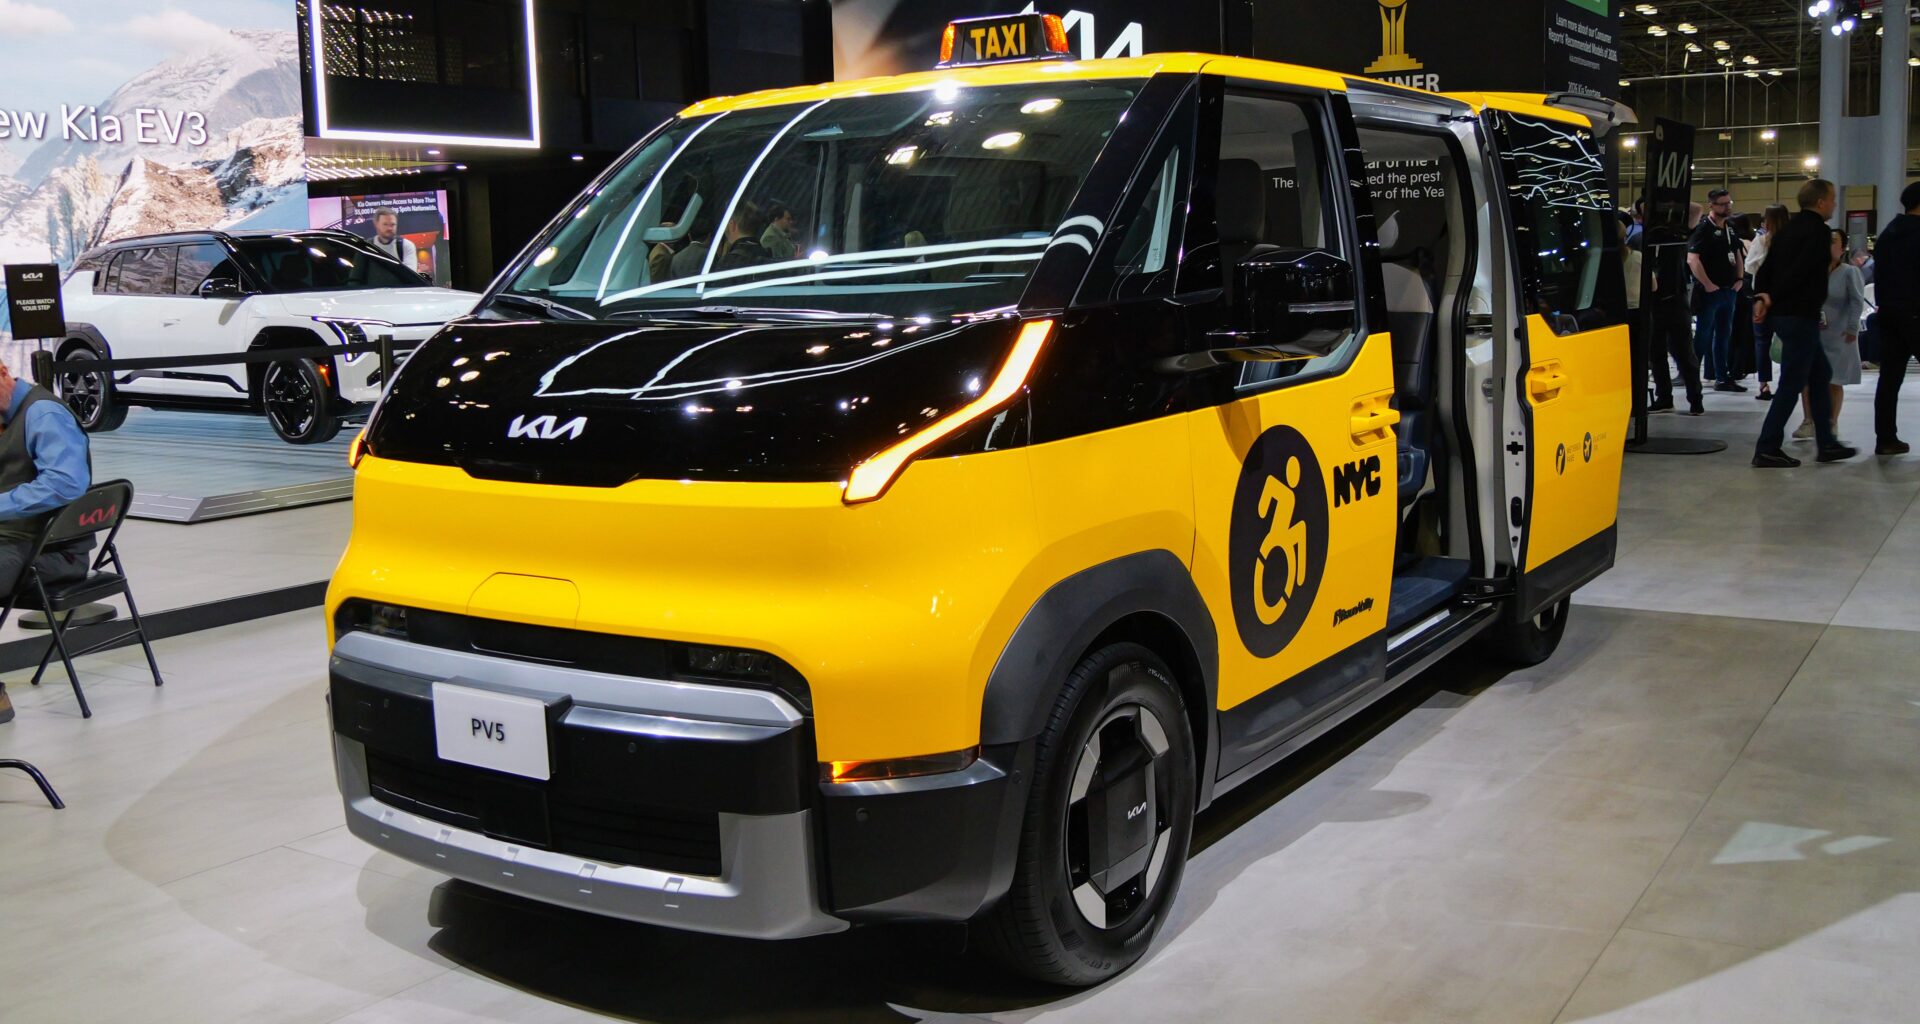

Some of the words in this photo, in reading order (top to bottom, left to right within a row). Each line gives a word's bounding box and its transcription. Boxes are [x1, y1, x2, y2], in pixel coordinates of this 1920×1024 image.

[971, 23, 1026, 61] TAXI
[61, 104, 122, 142] Kia
[136, 108, 208, 145] EV3
[1272, 177, 1294, 189] The
[1387, 172, 1407, 184] the
[1385, 187, 1398, 199] of
[1400, 186, 1420, 198] the
[507, 414, 588, 440] KIA
[1333, 455, 1381, 508] NYC
[471, 718, 505, 741] PV5
